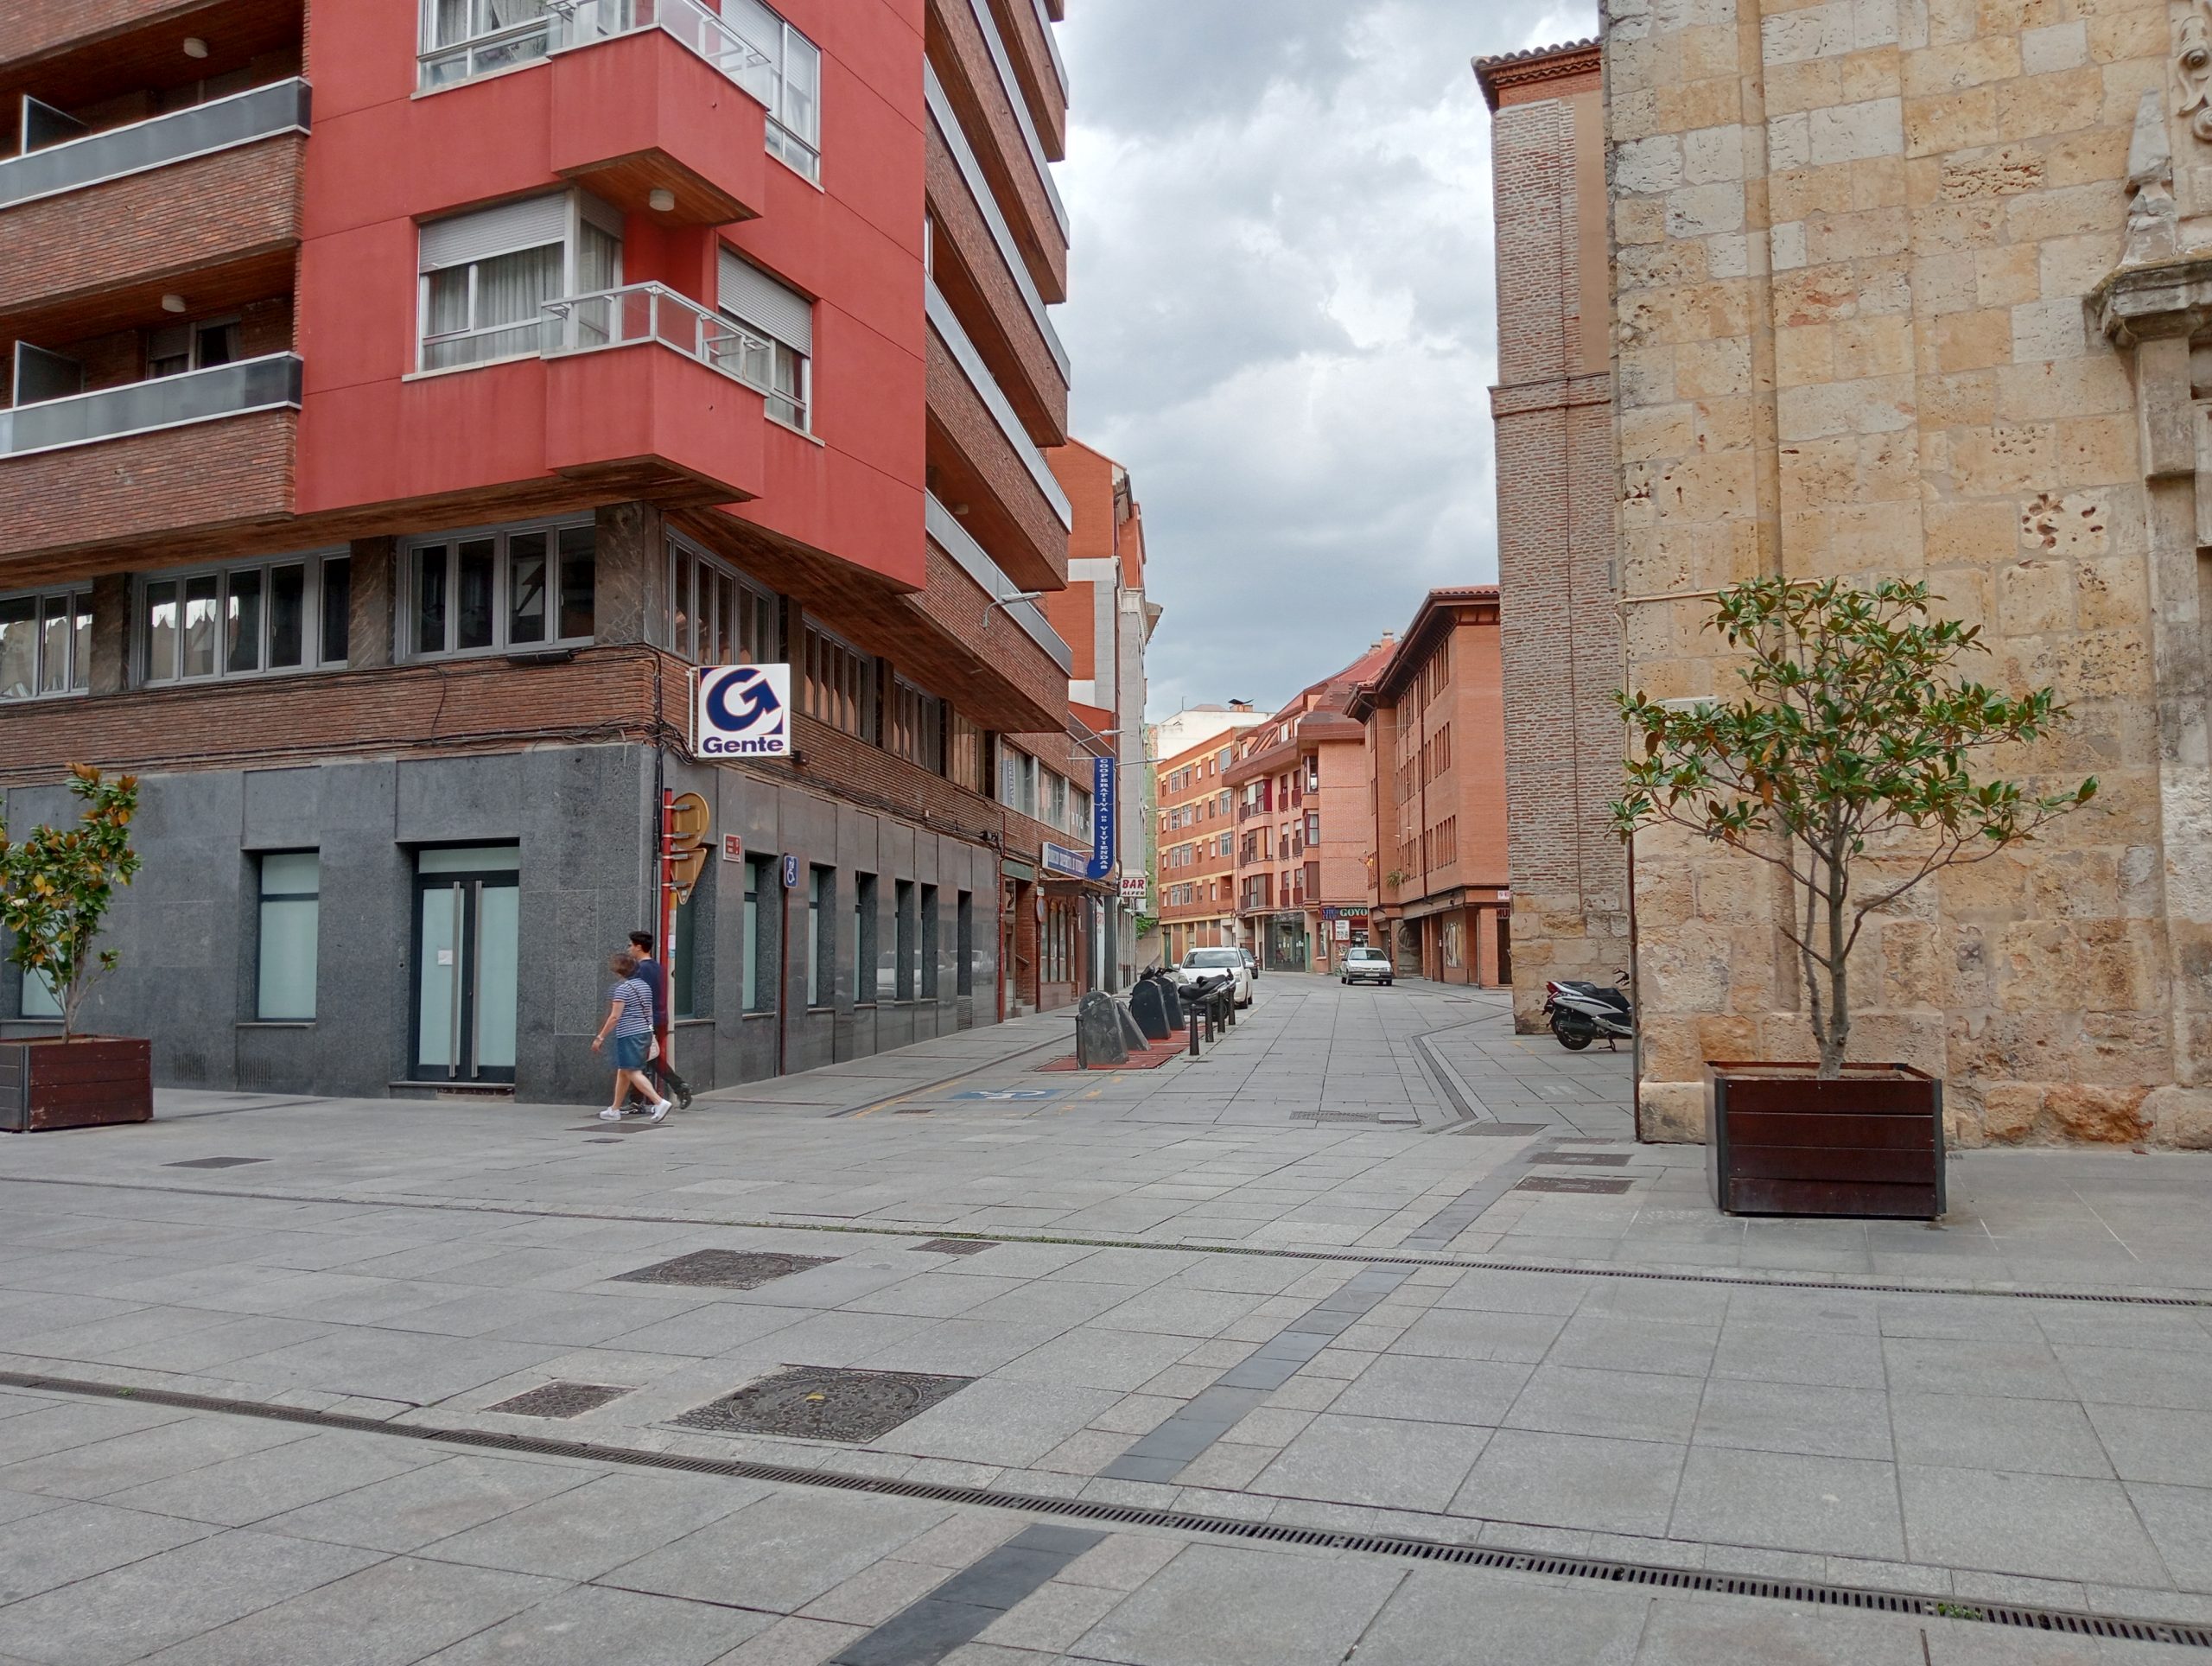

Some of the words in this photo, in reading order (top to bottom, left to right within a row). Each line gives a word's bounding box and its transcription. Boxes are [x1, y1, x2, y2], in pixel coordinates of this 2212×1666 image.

[702, 736, 784, 754] Gente
[1099, 759, 1109, 812] COOPERATIVA
[1099, 825, 1109, 870] VIVIENDAS
[1122, 879, 1145, 890] BAR
[1339, 908, 1368, 917] GOYO
